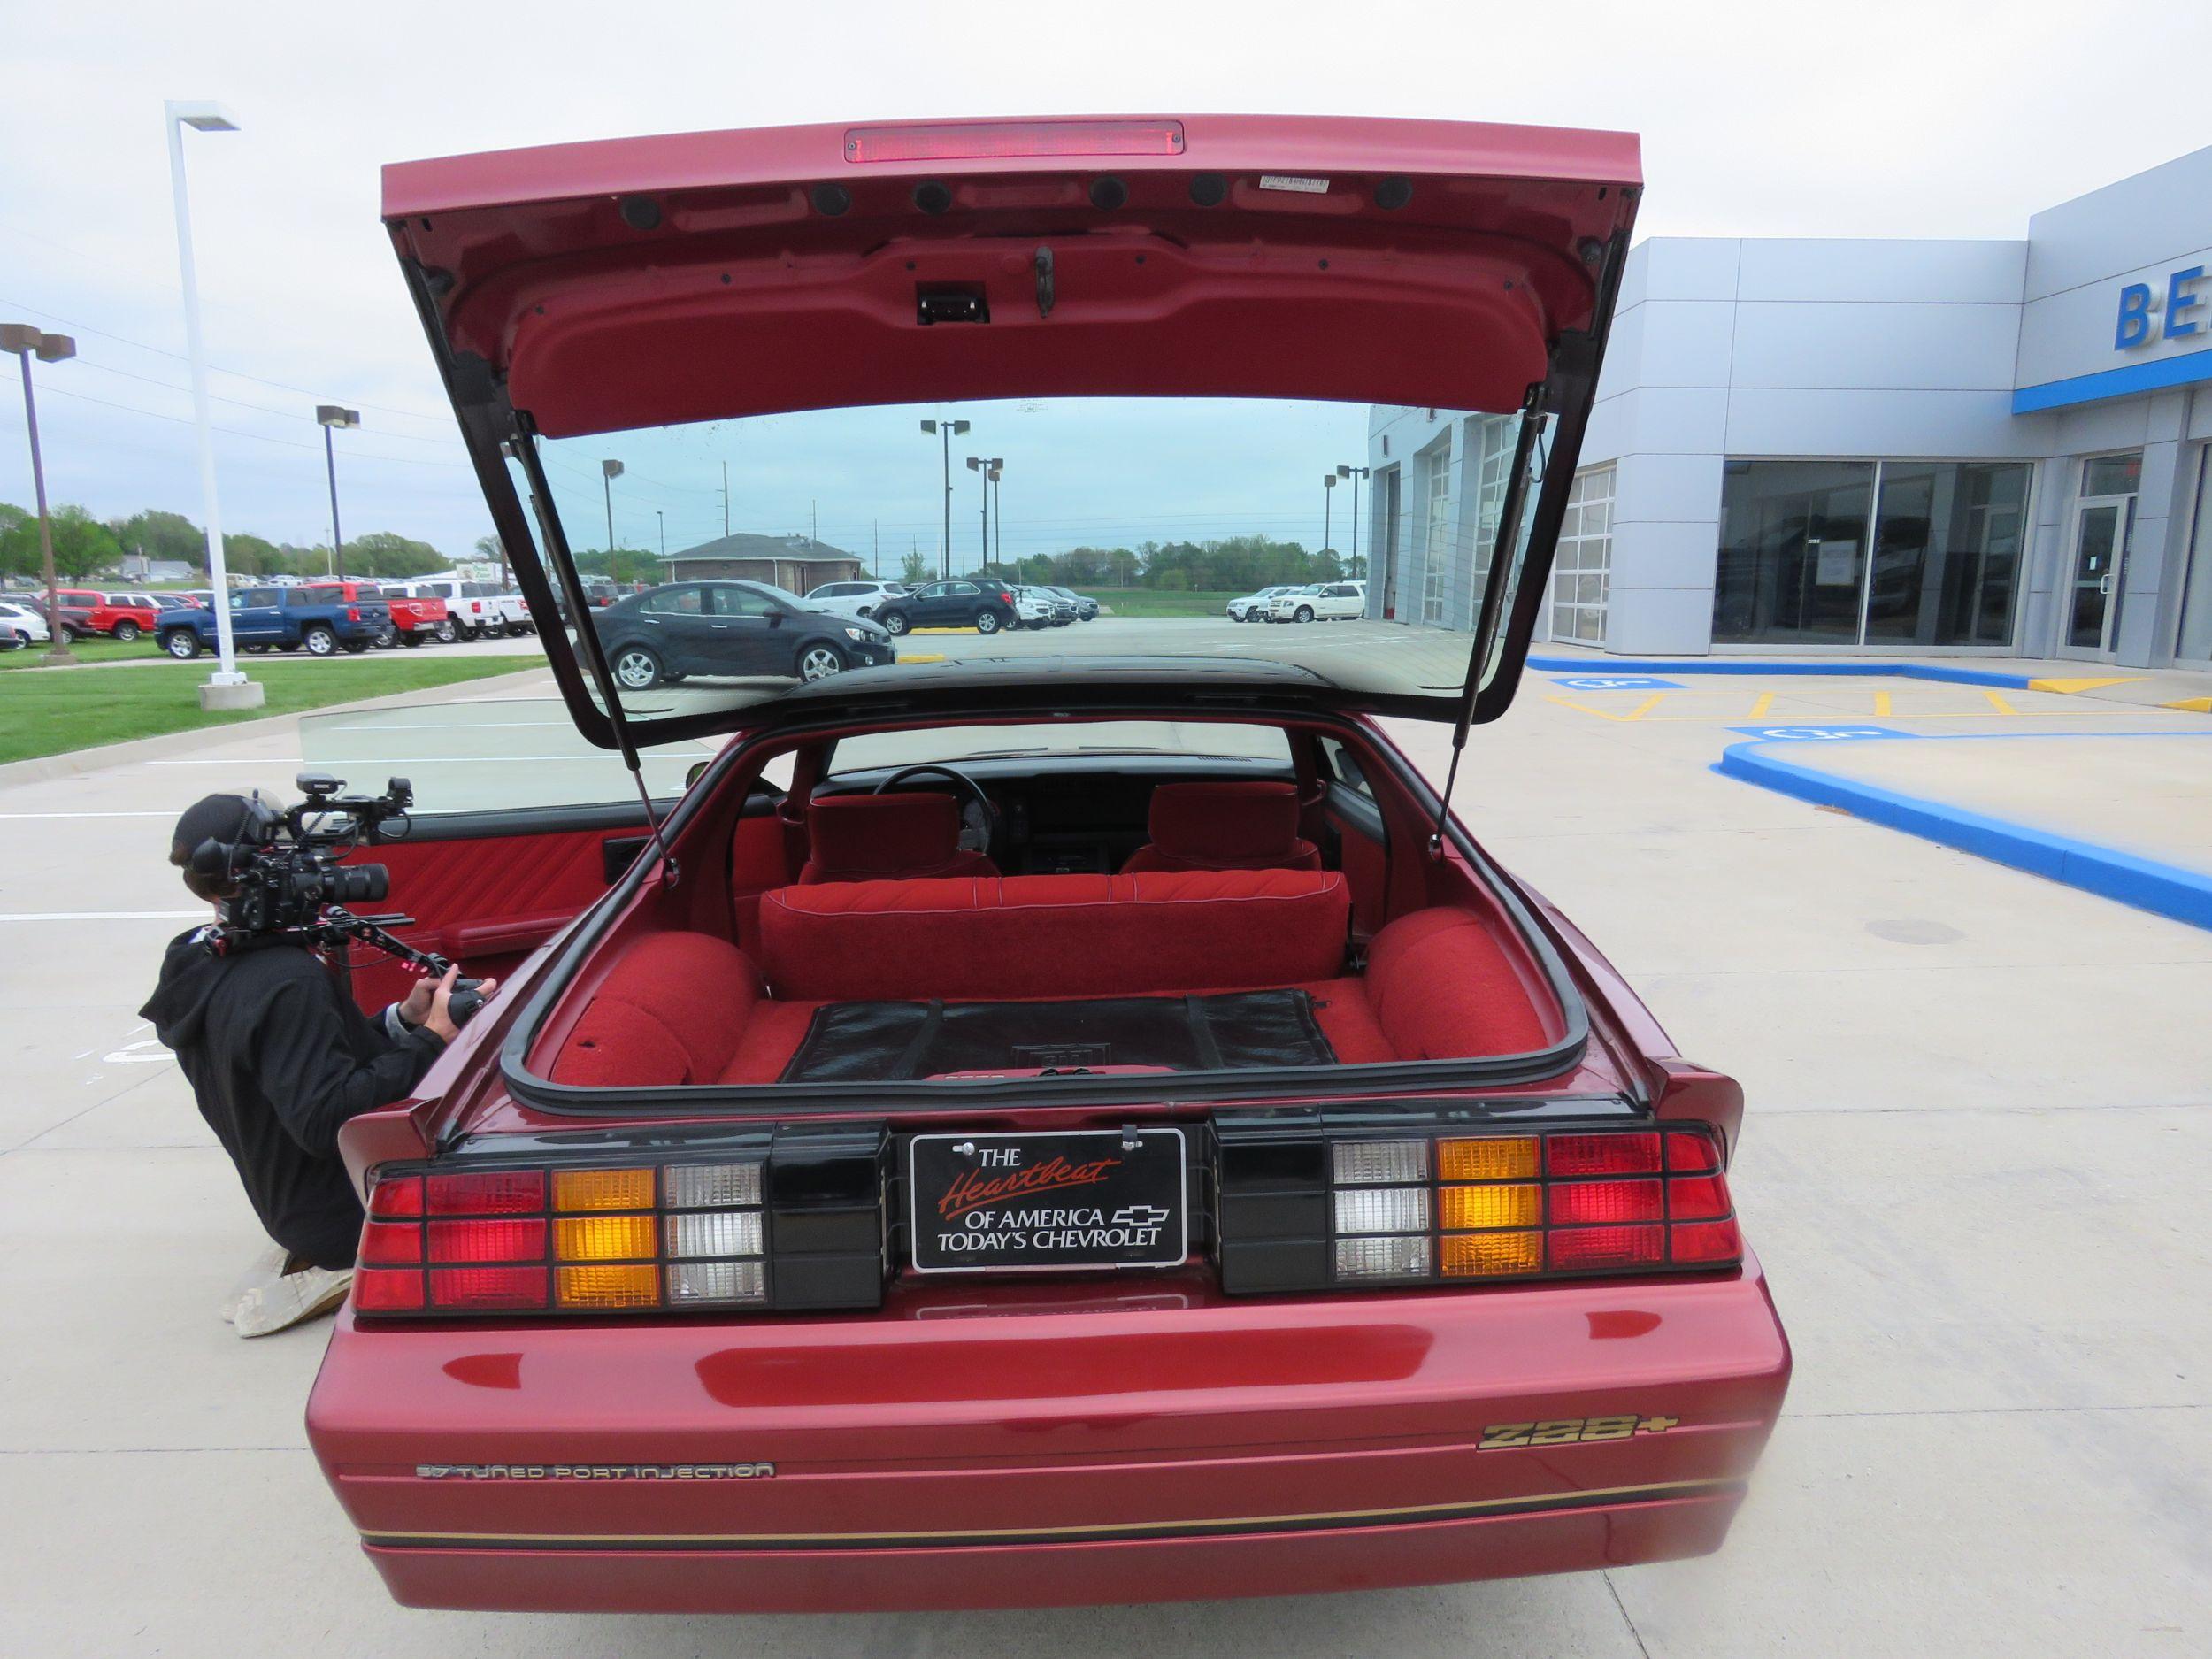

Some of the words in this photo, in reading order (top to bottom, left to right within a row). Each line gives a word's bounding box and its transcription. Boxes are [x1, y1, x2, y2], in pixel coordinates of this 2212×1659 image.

[2114, 265, 2212, 351] BE
[979, 1148, 1021, 1167] THE
[938, 1156, 1122, 1215] Heartbeat
[964, 1210, 996, 1230] OF
[998, 1209, 1105, 1229] AMERICA
[937, 1231, 1026, 1252] TODAY'S
[1033, 1227, 1162, 1249] CHEVROLET
[456, 1464, 545, 1479] TUNED
[555, 1466, 627, 1479] PORT
[634, 1463, 776, 1479] INJECTION
